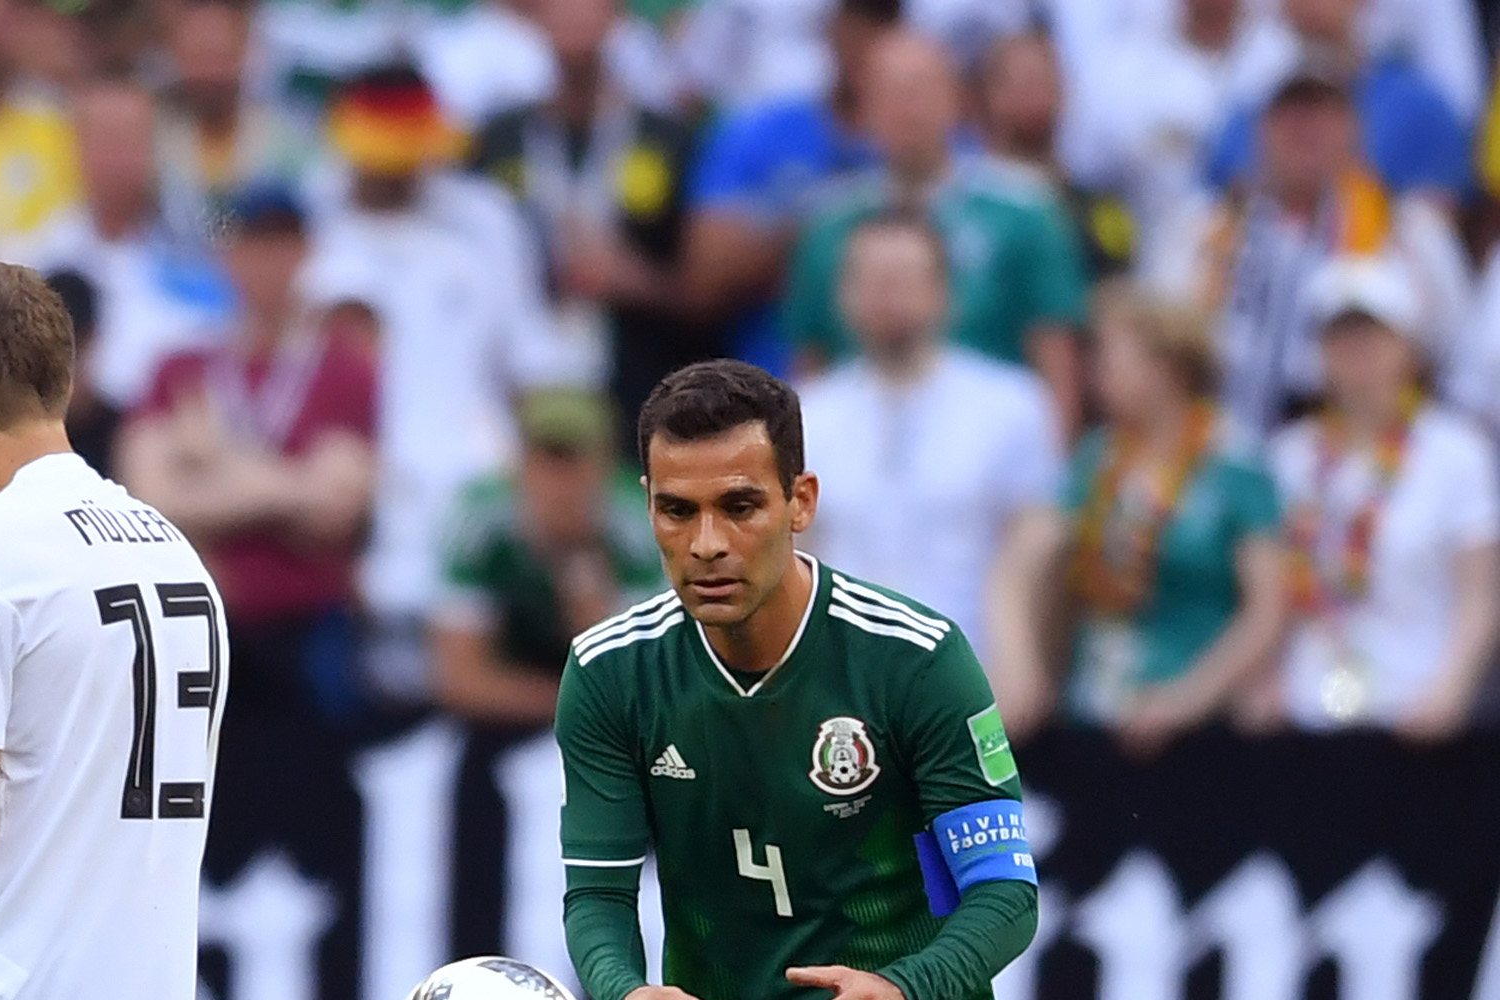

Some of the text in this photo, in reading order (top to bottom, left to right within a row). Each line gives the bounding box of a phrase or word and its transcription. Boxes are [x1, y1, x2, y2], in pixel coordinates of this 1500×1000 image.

[63, 499, 182, 546] MÜLLER
[94, 582, 224, 819] 13
[650, 765, 696, 780] adidas
[947, 813, 1027, 840] LIVIN
[951, 826, 1028, 854] FOOTBAL
[732, 828, 794, 918] 4
